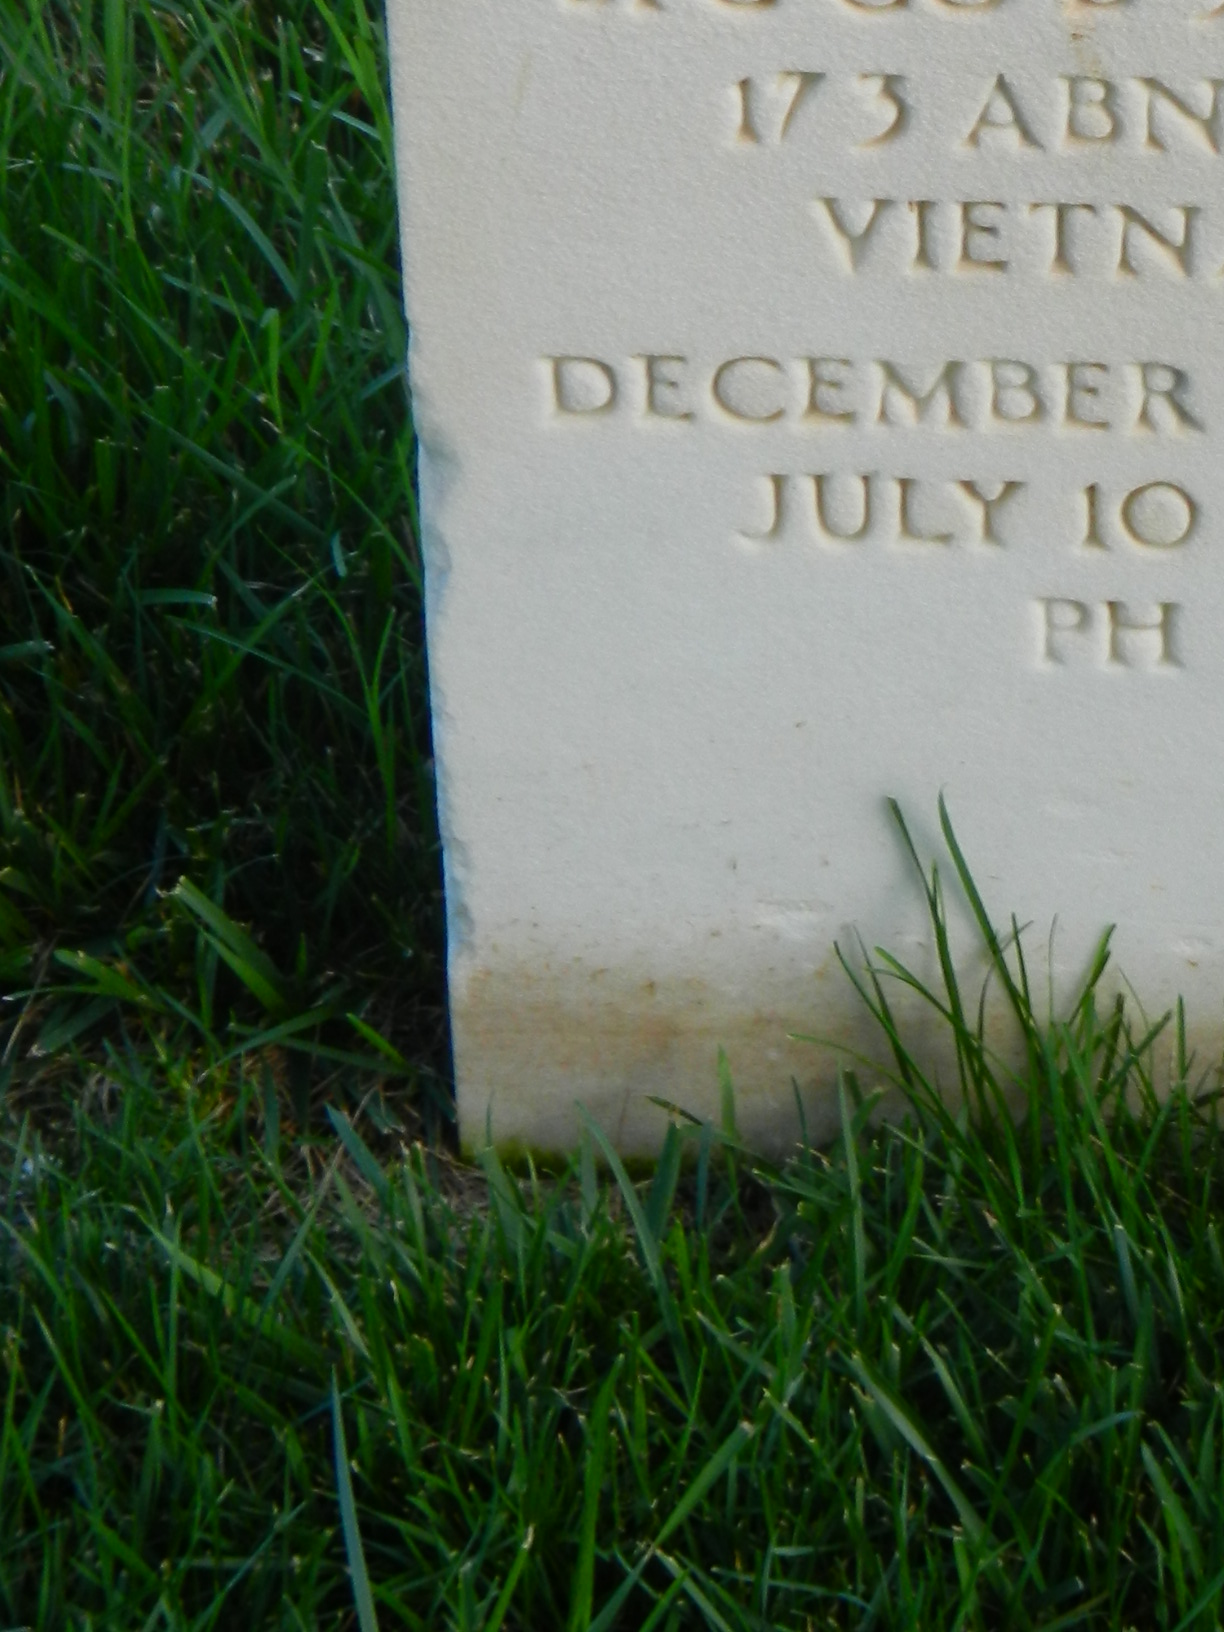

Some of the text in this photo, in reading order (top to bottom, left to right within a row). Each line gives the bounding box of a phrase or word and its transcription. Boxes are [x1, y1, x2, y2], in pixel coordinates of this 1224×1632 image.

[734, 70, 908, 150] 173
[540, 354, 1206, 434] DECEMBER
[736, 472, 1026, 550] JULY
[1078, 478, 1199, 553] 10
[1034, 596, 1184, 668] PH
